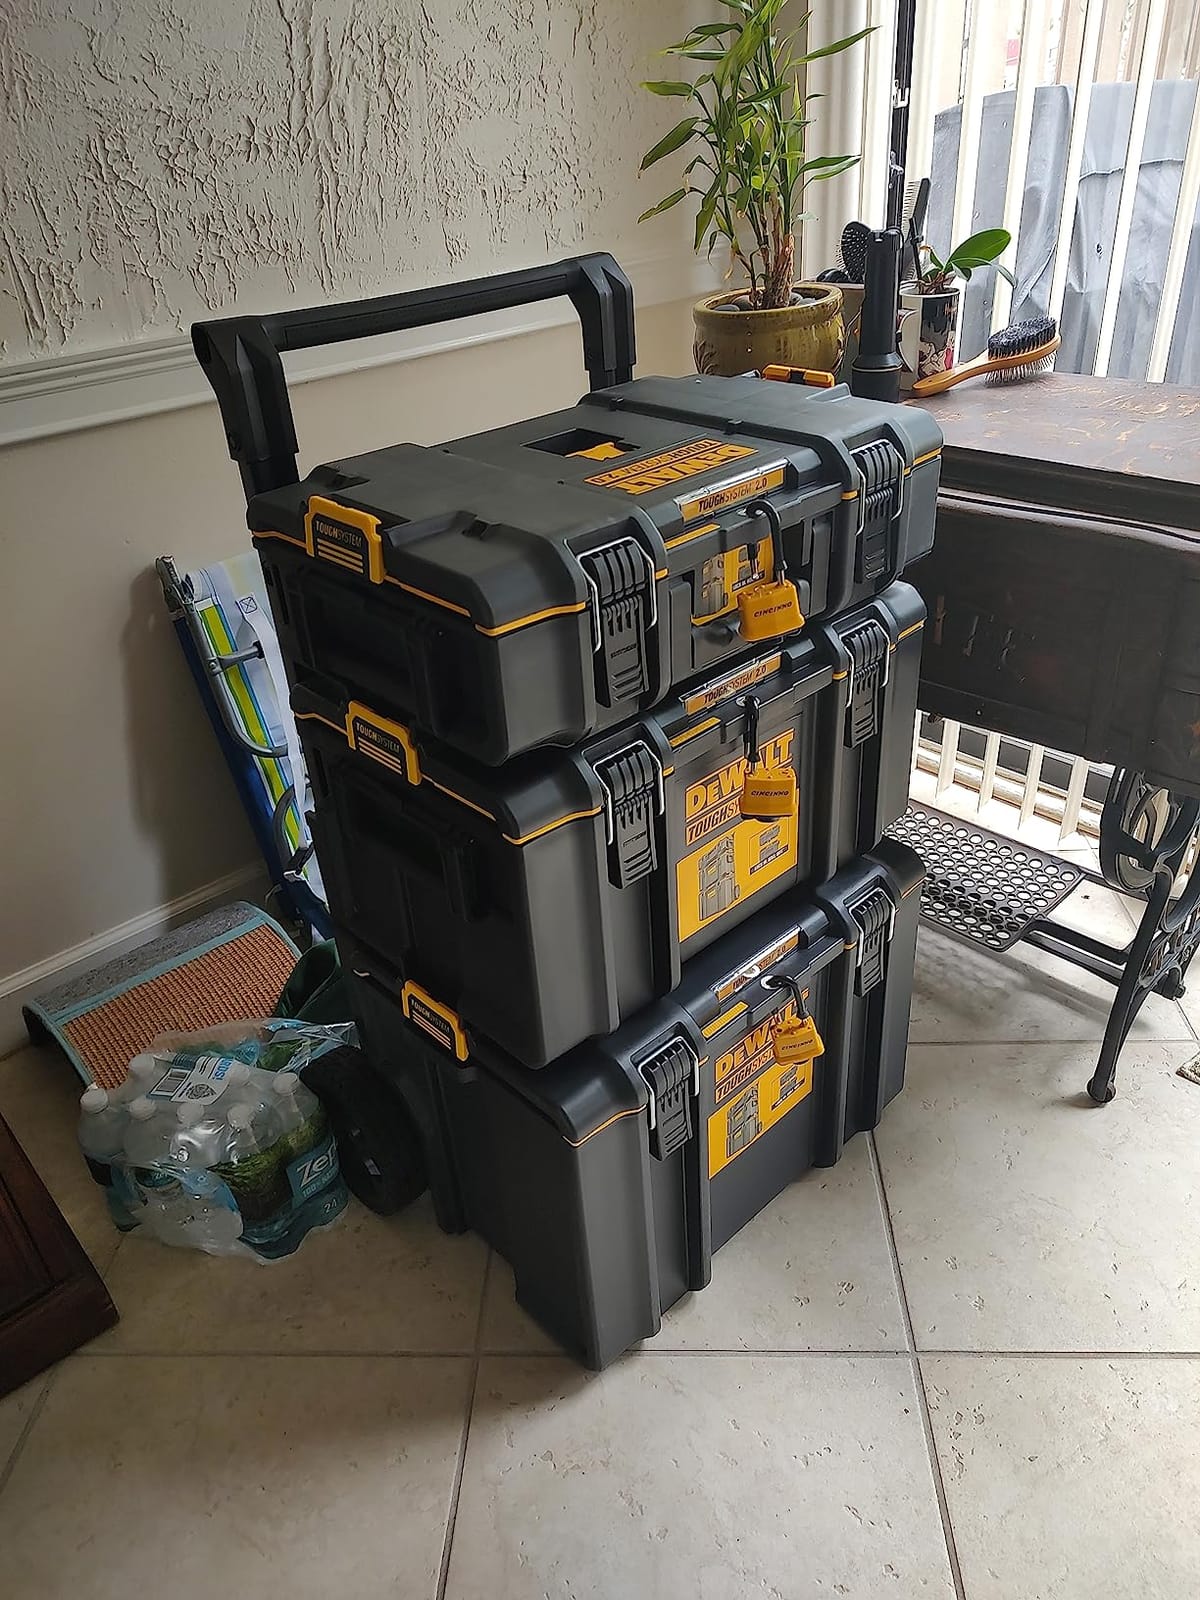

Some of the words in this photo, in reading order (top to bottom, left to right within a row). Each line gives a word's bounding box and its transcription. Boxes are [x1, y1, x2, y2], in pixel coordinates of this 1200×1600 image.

[617, 444, 755, 494] DEWALT
[698, 483, 751, 512] TOUGHSYSTEM
[755, 477, 767, 491] 2.0
[316, 520, 362, 547] TOUGHSYSTEM
[753, 601, 793, 618] CINCINNO
[703, 672, 753, 704] TOUGHSYSTEM
[755, 664, 767, 679] 2.0
[356, 721, 400, 753] TOUGHSYSTEM
[751, 789, 790, 798] CINCINNO
